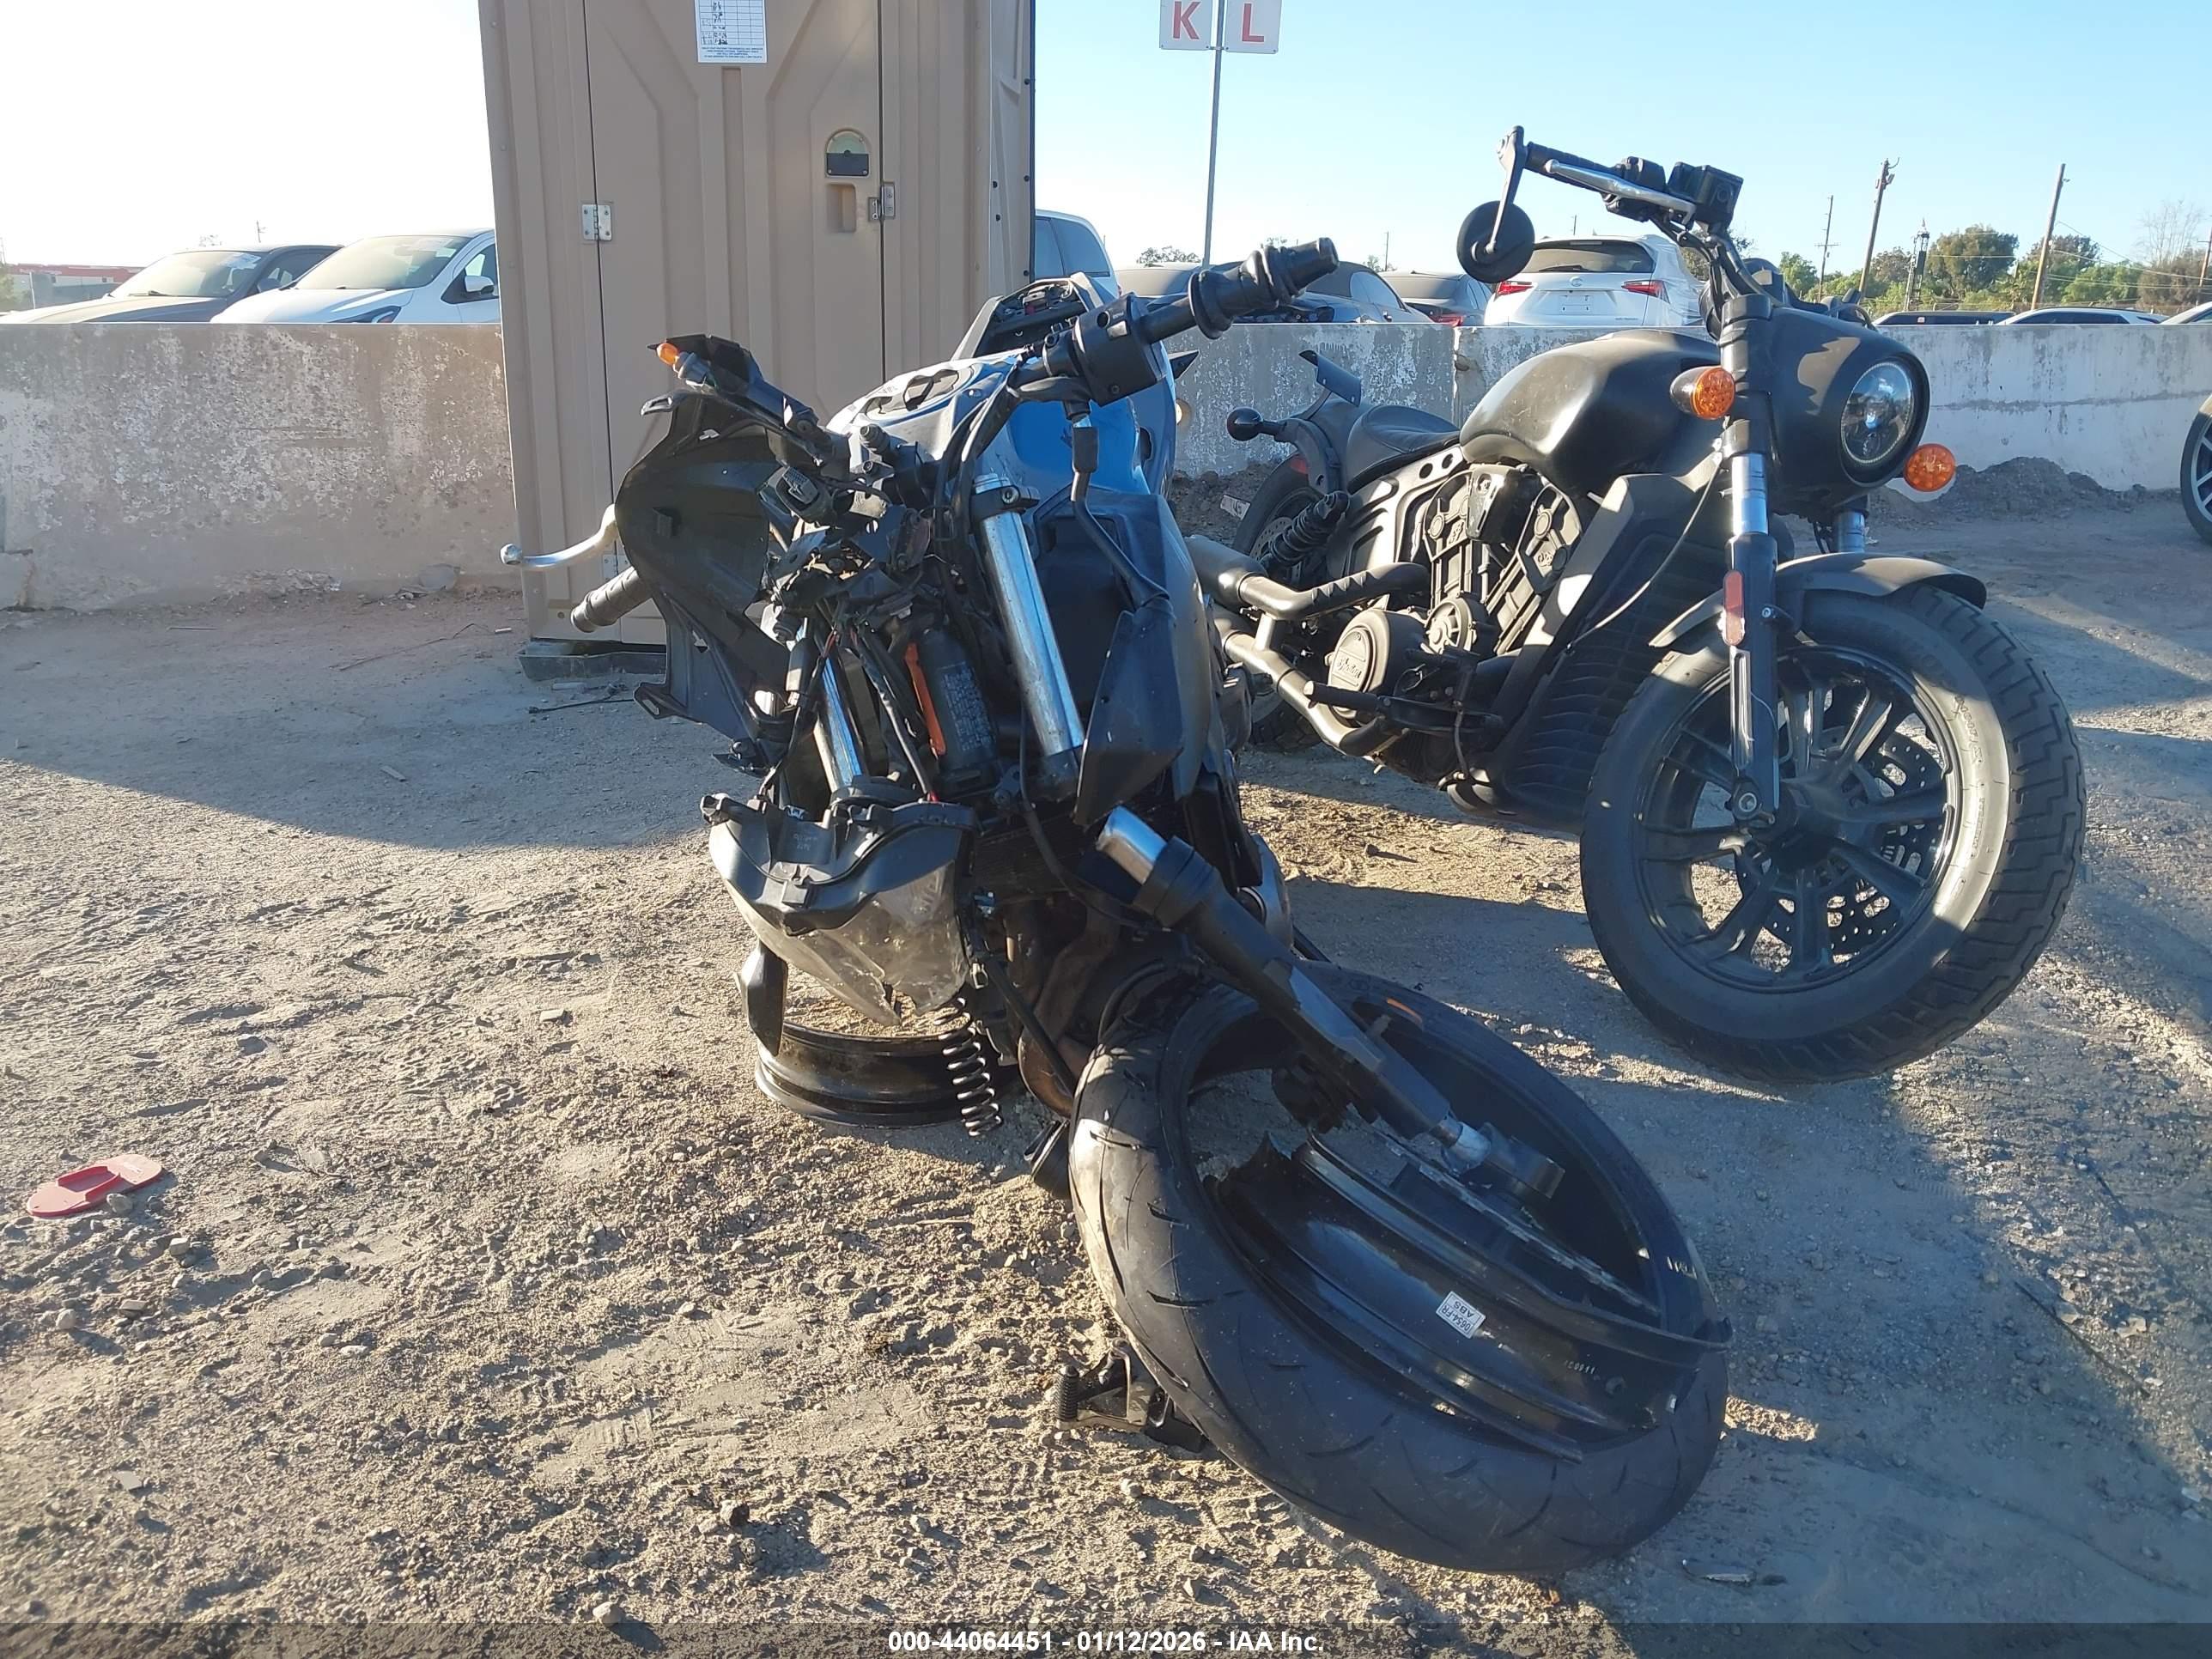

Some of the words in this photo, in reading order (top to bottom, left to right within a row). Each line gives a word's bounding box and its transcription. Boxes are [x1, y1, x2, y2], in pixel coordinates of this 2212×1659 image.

[1173, 1, 1201, 40] K
[1242, 3, 1265, 42] L
[1454, 1301, 1474, 1318] ABS
